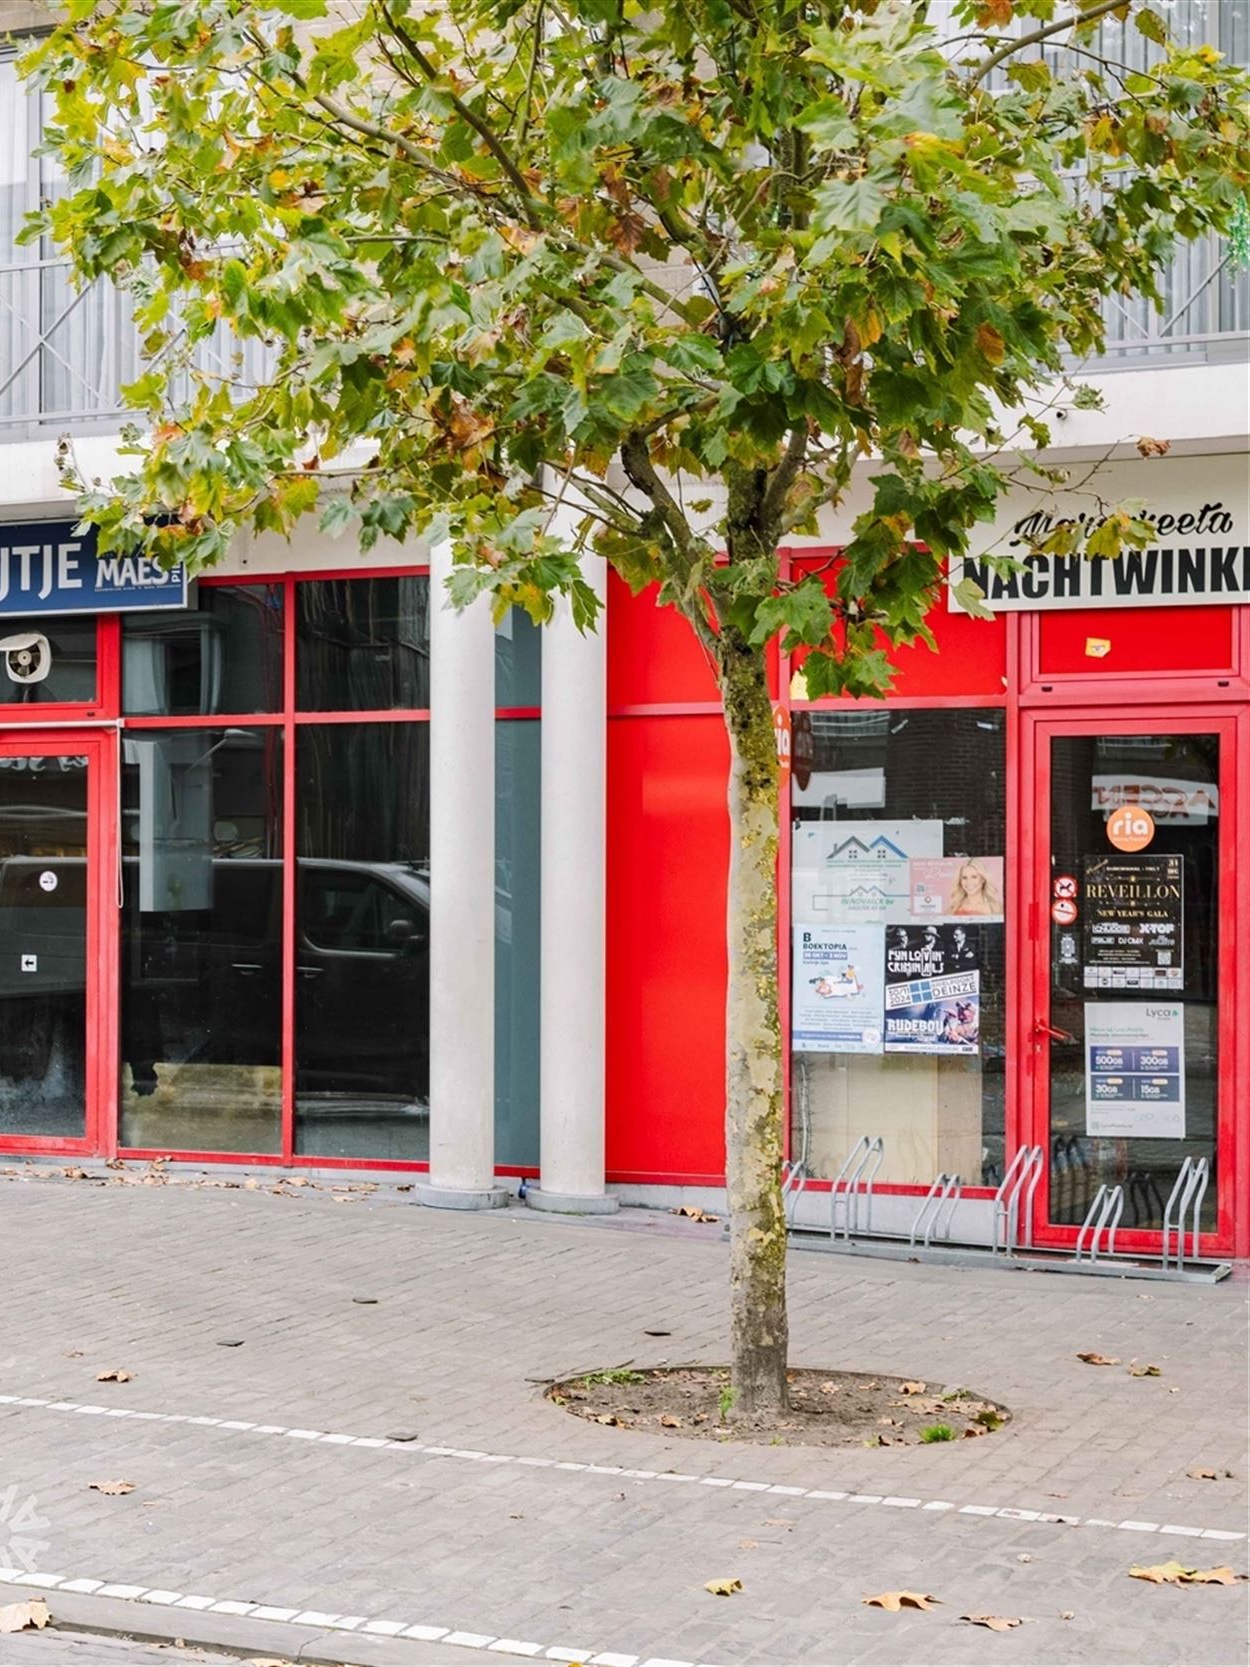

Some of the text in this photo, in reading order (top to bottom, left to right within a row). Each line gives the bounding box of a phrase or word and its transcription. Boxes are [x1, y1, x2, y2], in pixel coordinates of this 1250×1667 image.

[95, 557, 170, 588] MAES
[1113, 812, 1149, 835] ria
[1086, 884, 1181, 899] REVEILLON
[1097, 909, 1115, 917] NEW
[803, 932, 811, 942] B
[932, 982, 976, 997] DEINZE
[1146, 1008, 1171, 1018] Lyca
